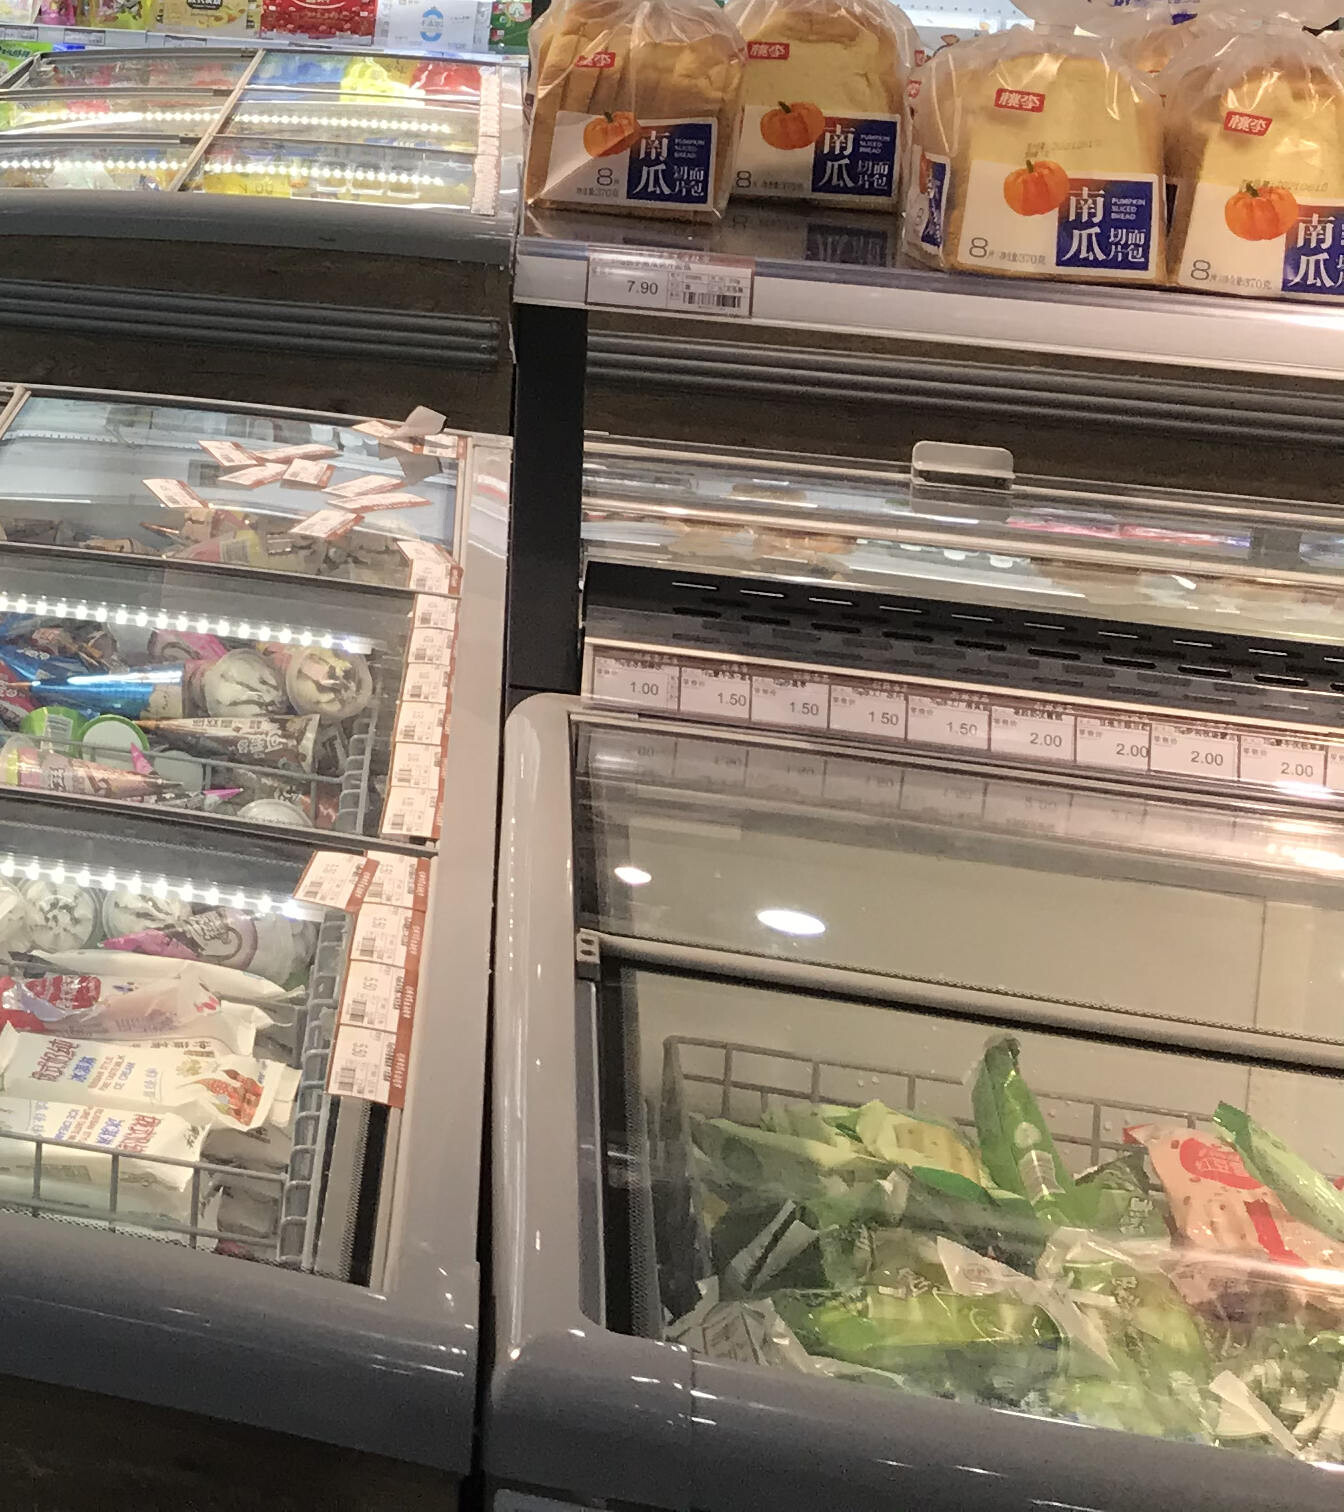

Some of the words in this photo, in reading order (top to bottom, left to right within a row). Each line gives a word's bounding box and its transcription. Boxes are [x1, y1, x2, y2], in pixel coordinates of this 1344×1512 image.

[998, 91, 1041, 109] 桃李
[1228, 114, 1268, 133] 桃李
[633, 130, 672, 195] 南瓜
[818, 124, 855, 188] 南瓜
[597, 168, 613, 186] 8
[1111, 197, 1146, 206] PUMPKIN
[1111, 205, 1137, 213] SLICED
[1062, 187, 1107, 262] 南瓜
[1288, 213, 1337, 288] 南瓜
[626, 280, 659, 295] 7.90
[629, 681, 659, 696] 1.00
[717, 692, 746, 707] 1.50
[789, 701, 819, 716] 1.50
[868, 710, 899, 726] 1.50
[945, 721, 977, 736] 1.50
[1030, 732, 1062, 747] 2.00
[1115, 743, 1149, 758] 2.00
[1190, 750, 1224, 766] 2.00
[1280, 761, 1314, 777] 2.00
